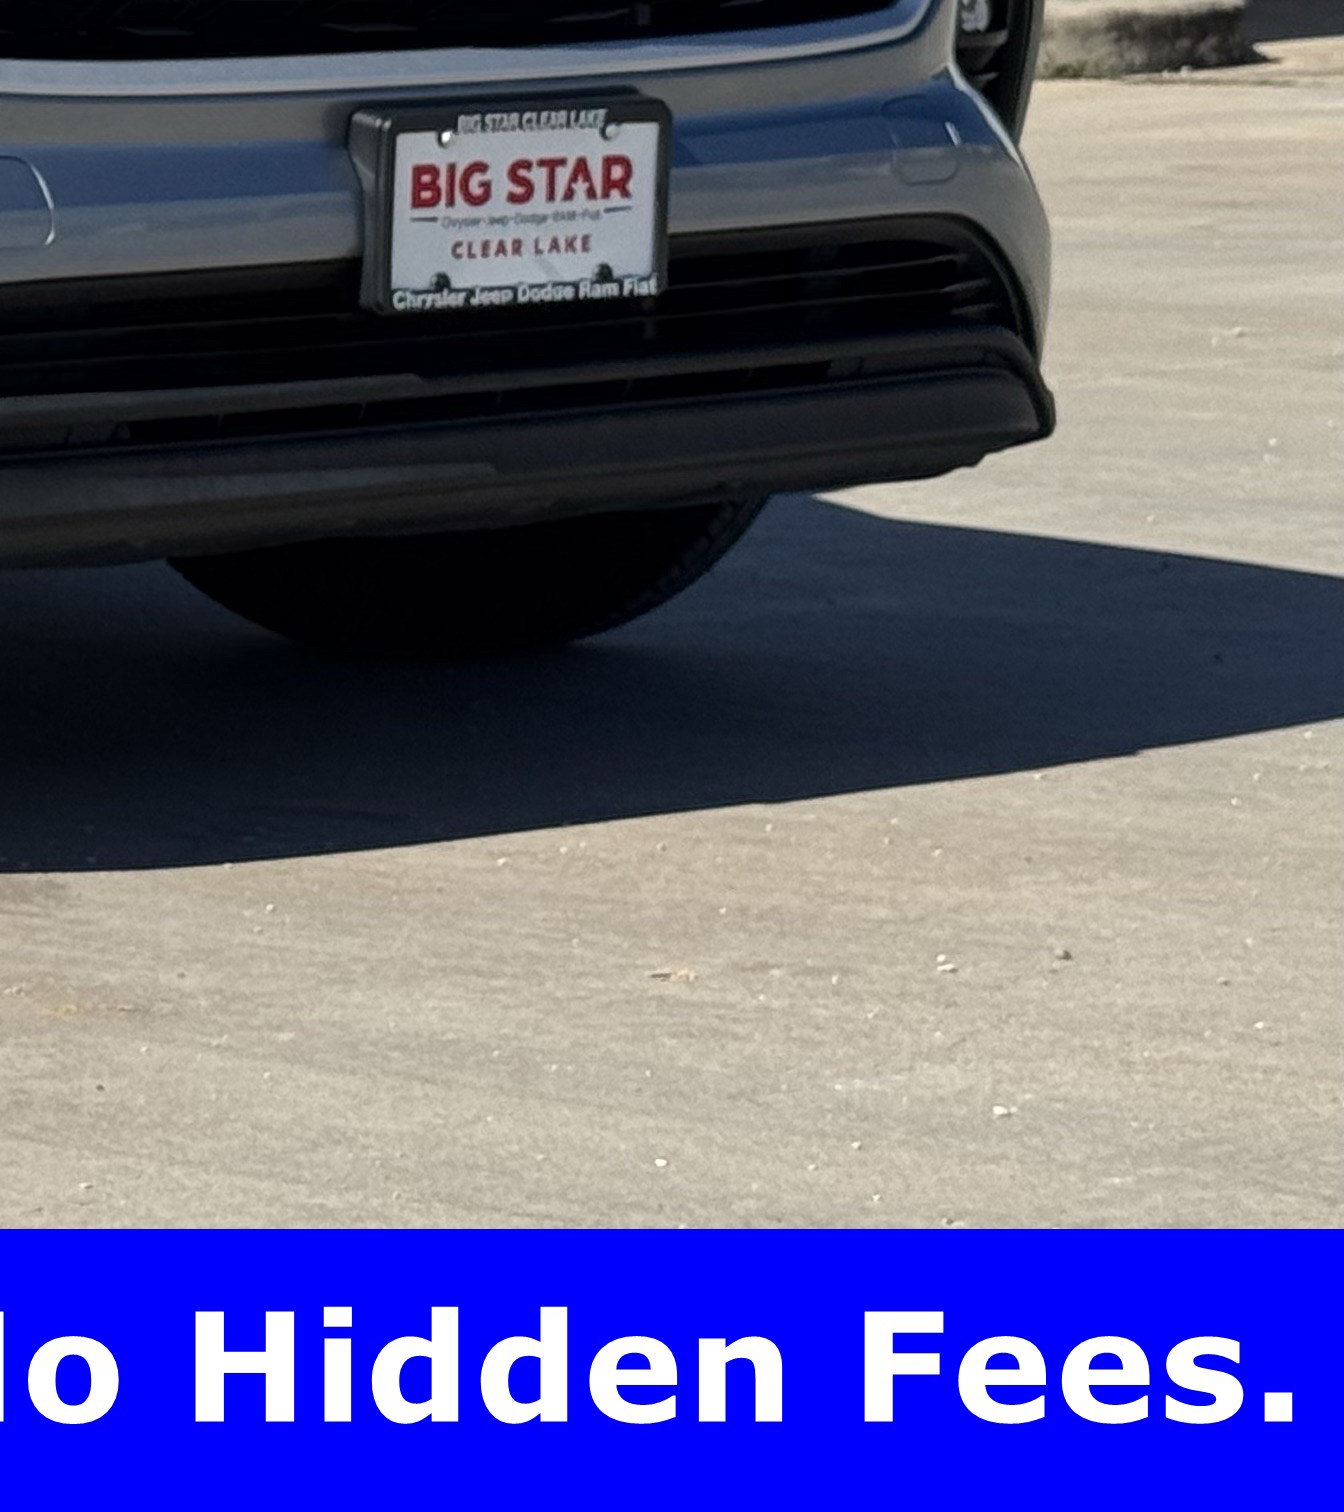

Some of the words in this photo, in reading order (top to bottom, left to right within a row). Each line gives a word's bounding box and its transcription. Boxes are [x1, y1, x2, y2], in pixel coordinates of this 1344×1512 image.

[410, 161, 492, 209] BIG
[506, 154, 633, 205] STAR
[450, 238, 522, 260] CLEAR
[535, 235, 592, 257] LAKE
[392, 289, 467, 311] Chrysler
[469, 287, 513, 307] Jeep
[622, 276, 658, 297] Fiat
